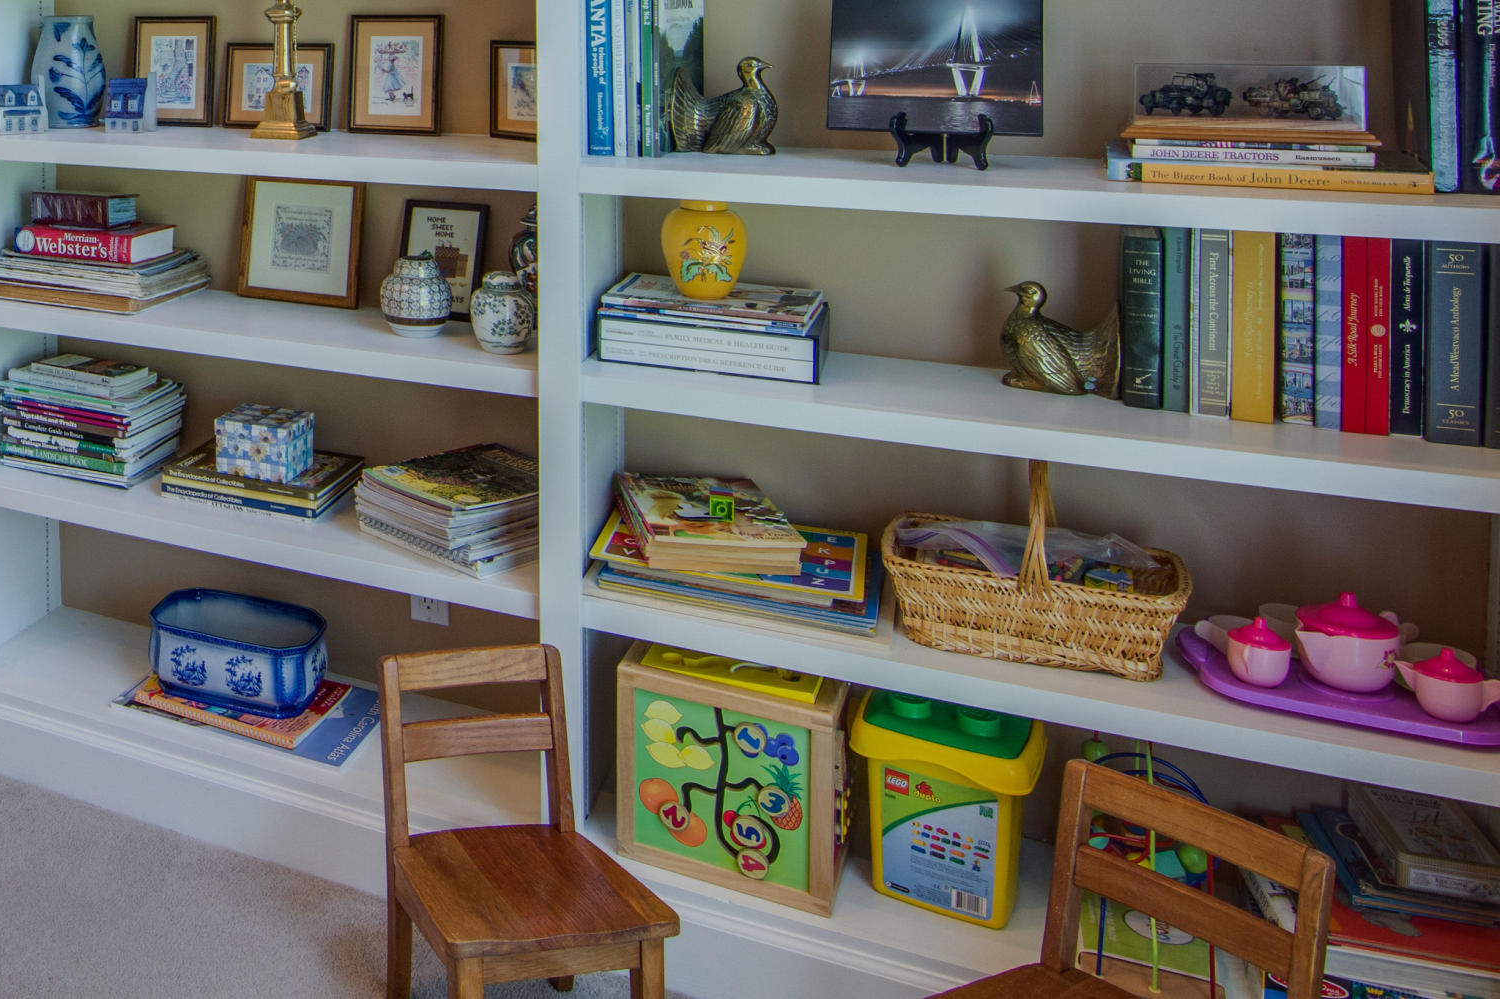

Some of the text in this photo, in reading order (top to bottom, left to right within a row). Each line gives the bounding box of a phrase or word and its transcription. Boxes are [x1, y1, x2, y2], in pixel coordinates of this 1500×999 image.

[1150, 149, 1180, 158] JOHN
[1181, 150, 1220, 160] DEERE
[1222, 151, 1280, 162] TRACTORS
[1150, 170, 1330, 186] The Bigger Book of John Deere
[63, 232, 100, 243] Merriam-
[36, 237, 108, 258] Webster's
[1448, 254, 1464, 263] 50
[1129, 268, 1156, 276] LIVING
[1133, 277, 1152, 285] BIBLE
[1209, 252, 1220, 351] First Across the Continent
[1347, 292, 1360, 366] A Silk Road Journey
[693, 337, 725, 346] MEDICAL
[766, 343, 791, 352] GUIDE
[1450, 287, 1463, 391] A MeadWestvaco Anthology
[1172, 341, 1184, 359] Great
[1403, 344, 1411, 370] America
[763, 363, 786, 372] GUIDE
[1402, 380, 1410, 414] Democracy
[1448, 409, 1465, 418] 50
[24, 423, 47, 432] Complete
[48, 427, 63, 435] Guide
[70, 456, 87, 465] BOOK
[177, 471, 210, 482] Encyclopedia
[216, 477, 244, 487] Collectibles
[175, 487, 207, 499] Encyclopedia
[214, 494, 242, 504] Collectibles
[343, 717, 375, 743] Carolina
[737, 728, 760, 750] 1
[327, 743, 350, 760] Atlas
[887, 775, 908, 788] LEGO
[760, 793, 785, 813] 3
[914, 790, 940, 803] duplo
[663, 805, 685, 828] 2
[736, 823, 760, 842] 5
[741, 855, 766, 872] 4
